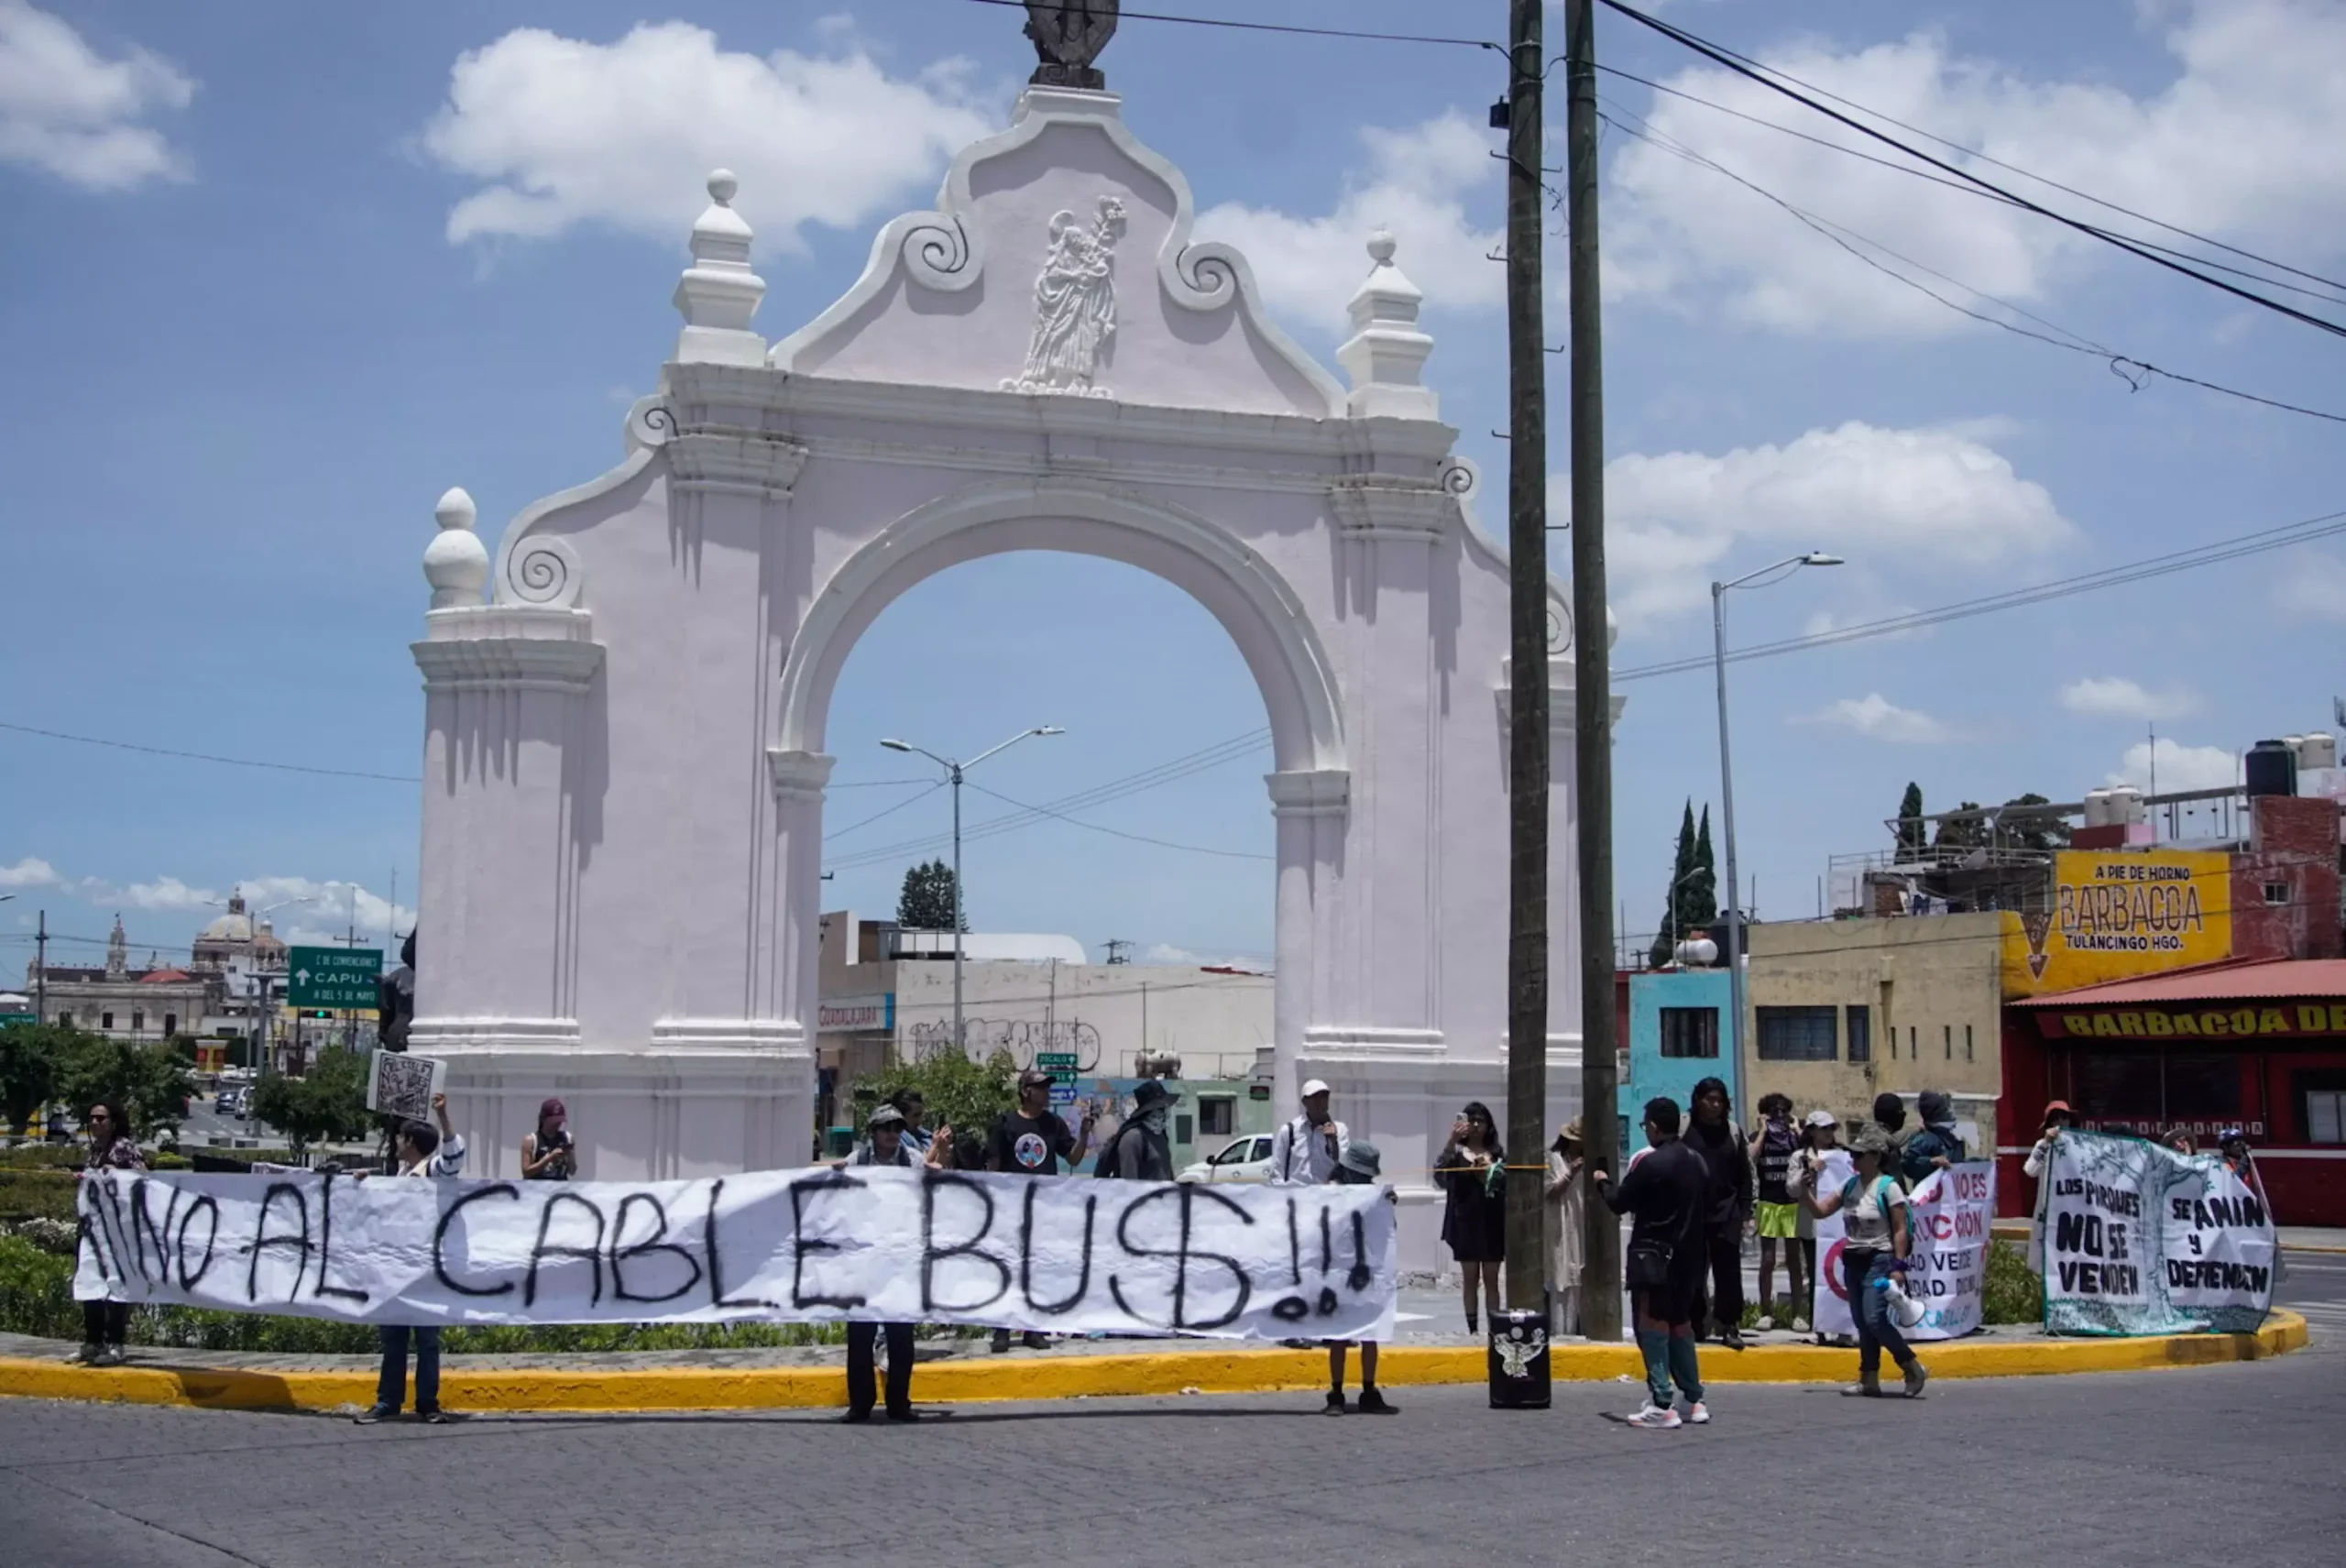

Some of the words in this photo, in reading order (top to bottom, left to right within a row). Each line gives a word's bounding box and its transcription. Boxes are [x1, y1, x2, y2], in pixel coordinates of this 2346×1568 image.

[2095, 865, 2105, 879] A
[2108, 865, 2126, 880] PIE
[2130, 865, 2144, 880] DE
[2149, 867, 2190, 881] HORNO
[2059, 884, 2204, 933] BARBACOA
[2066, 935, 2148, 949] TULANCINGO
[2153, 935, 2185, 949] HGO.
[314, 972, 363, 984] CAPU
[2063, 1008, 2291, 1036] BARBACOA
[1971, 1172, 1988, 1200] ES
[2055, 1179, 2083, 1196] LOS
[2173, 1198, 2192, 1221] SE
[240, 1174, 369, 1303] AL
[2055, 1212, 2103, 1257] NO
[2109, 1223, 2128, 1259] SE
[2057, 1261, 2140, 1295] VENDEN
